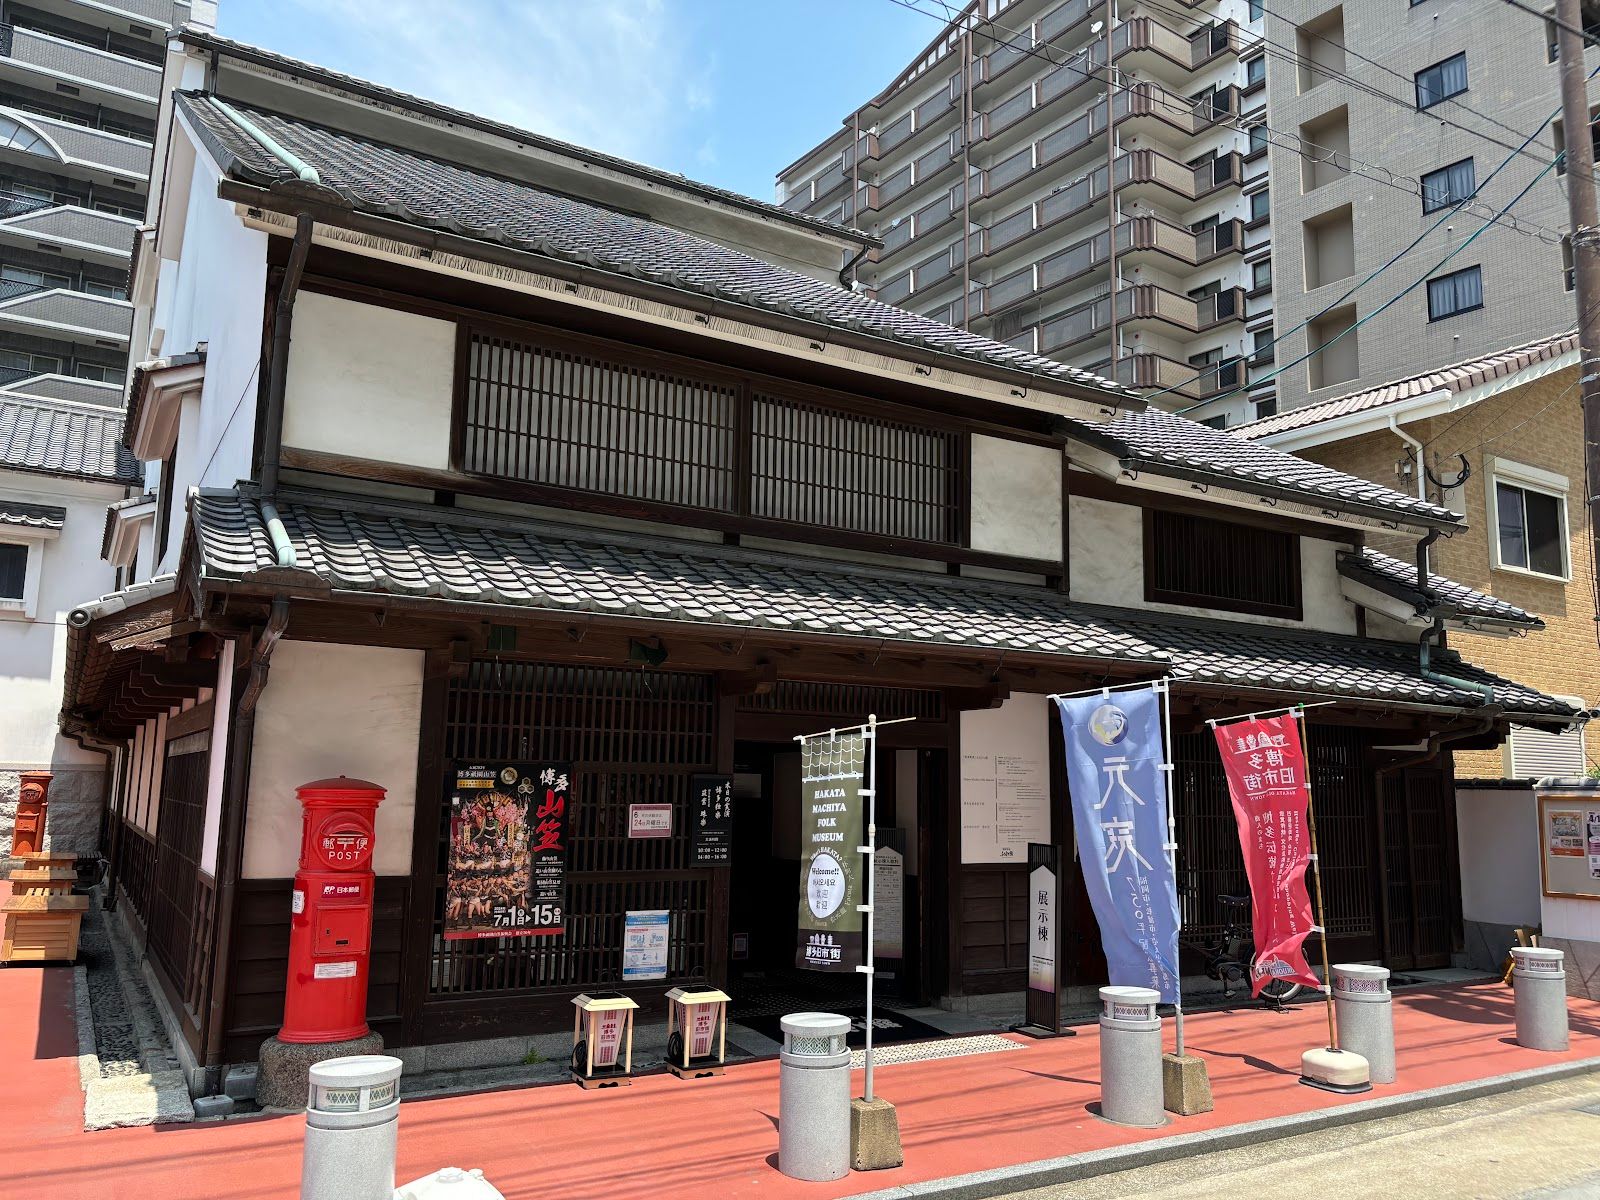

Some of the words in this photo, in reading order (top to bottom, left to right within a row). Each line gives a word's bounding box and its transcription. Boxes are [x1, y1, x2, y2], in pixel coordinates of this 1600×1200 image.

[540, 767, 569, 793] 博多
[814, 788, 846, 799] HAKATA
[812, 803, 847, 814] MACHIYA
[532, 788, 565, 852] 山笠
[817, 818, 837, 828] FOLK
[811, 833, 844, 843] MUSEUM
[328, 851, 360, 860] POST
[1037, 890, 1049, 942] 展示棟
[805, 945, 841, 960] 博多旧市街
